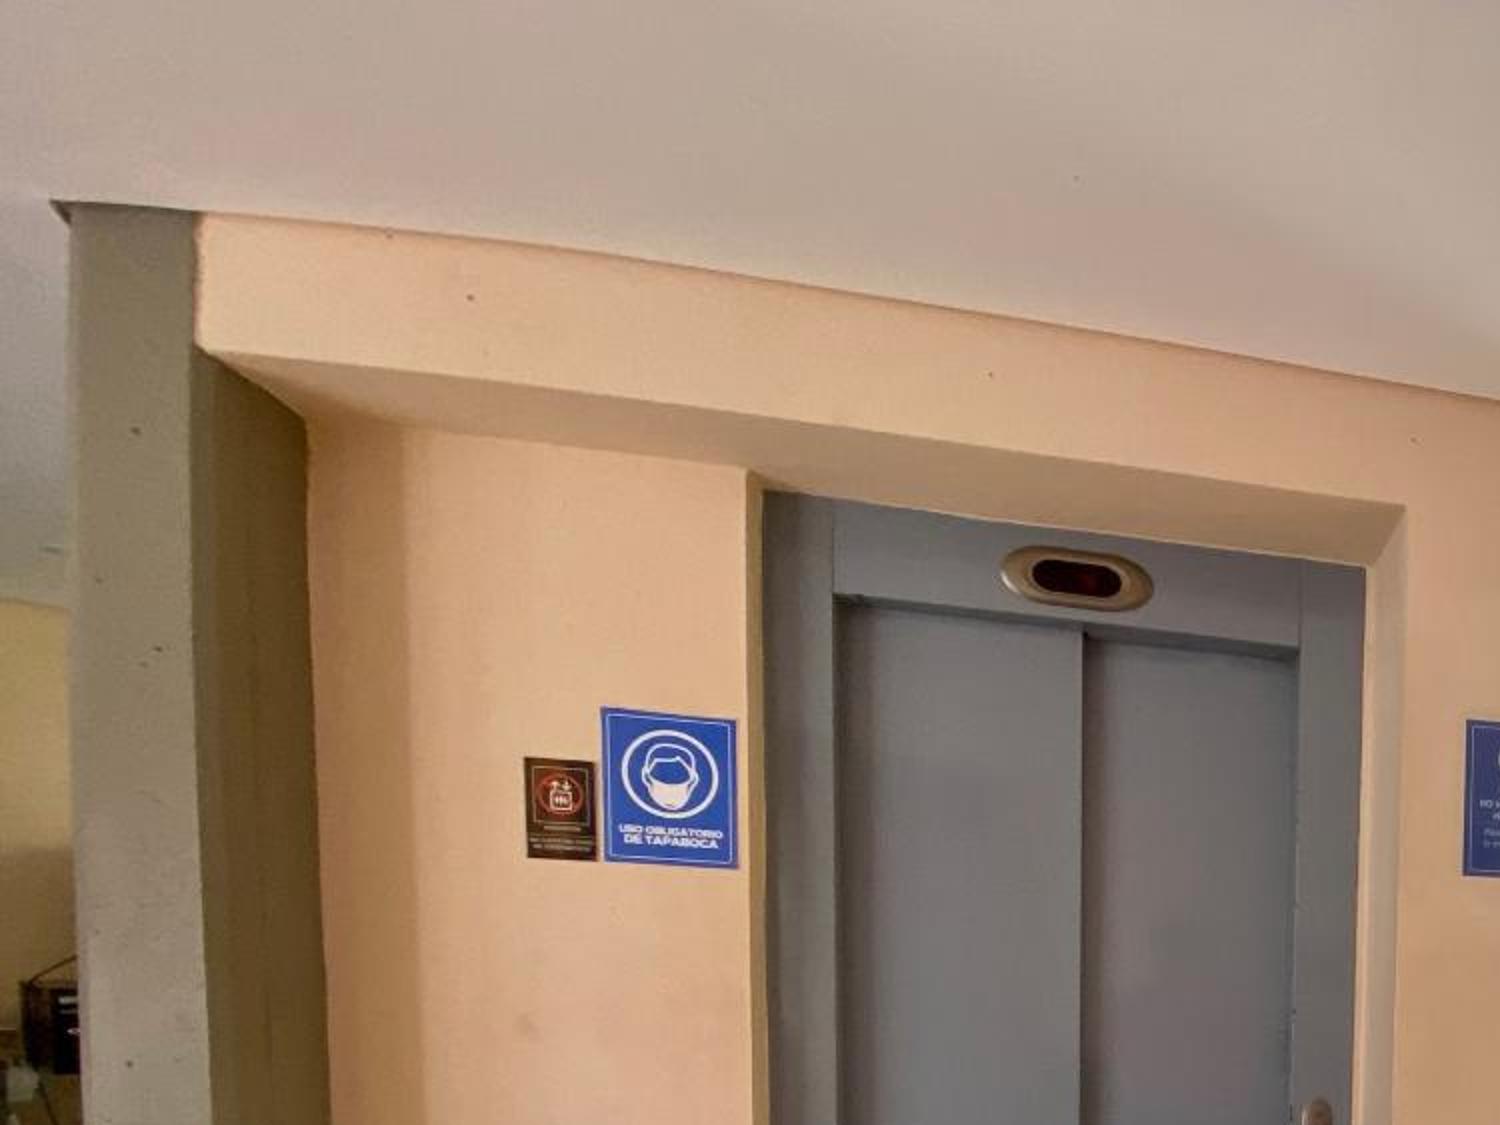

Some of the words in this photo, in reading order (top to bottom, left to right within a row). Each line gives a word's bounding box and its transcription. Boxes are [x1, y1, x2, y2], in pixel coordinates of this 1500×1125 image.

[618, 823, 643, 834] USO
[645, 825, 724, 839] OBLIGATORIO
[623, 833, 643, 844] DE
[645, 835, 719, 849] TAPABOCA
